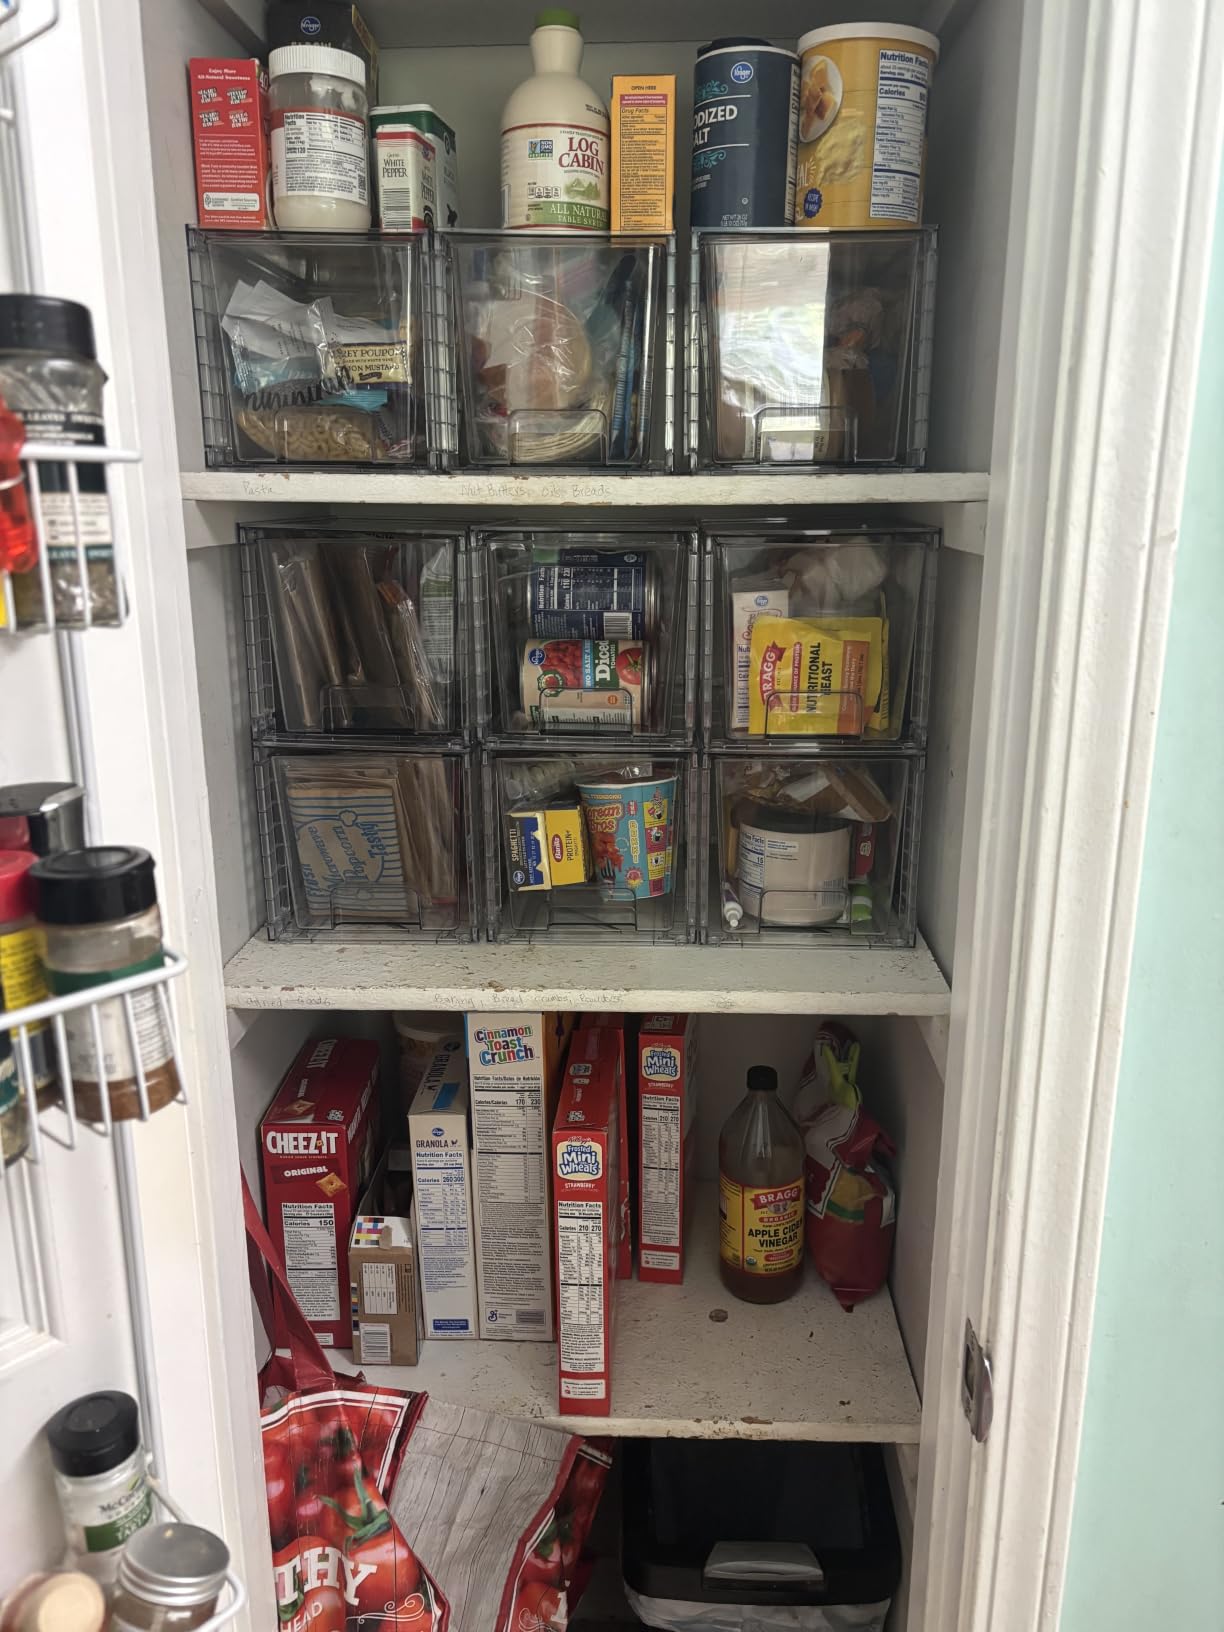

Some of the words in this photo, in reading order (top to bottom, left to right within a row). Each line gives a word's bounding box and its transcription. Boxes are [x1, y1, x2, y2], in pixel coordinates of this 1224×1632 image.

[880, 52, 914, 64] Nutrition
[734, 66, 751, 80] Kroger
[879, 88, 906, 96] Calories
[568, 137, 599, 157] LOG
[384, 159, 405, 167] WHITE
[558, 152, 604, 176] CABIN
[382, 168, 408, 178] PEPPER
[551, 203, 570, 214] ALL
[558, 215, 581, 224] TABLE
[532, 649, 543, 665] Kroger
[595, 640, 611, 681] Diced
[584, 676, 592, 687] NO
[805, 642, 821, 712] NUTRITIONAL
[587, 803, 622, 820] orean
[510, 829, 519, 862] SPAGHETTI
[308, 826, 345, 889] Microwave
[332, 826, 368, 882] Popcorn
[476, 1026, 532, 1041] Cinnamon
[487, 1037, 522, 1051] Toast
[481, 1045, 534, 1065] Crunch
[647, 1057, 675, 1066] Mini
[645, 1065, 676, 1076] Wheats
[416, 1140, 449, 1148] GRANOLA
[564, 1152, 596, 1164] Mini
[284, 1165, 328, 1177] ORIGINAL
[560, 1162, 598, 1174] Wheats
[759, 1188, 798, 1203] BRAGG
[748, 1228, 780, 1238] APPLE
[759, 1232, 798, 1248] VINEGAR
